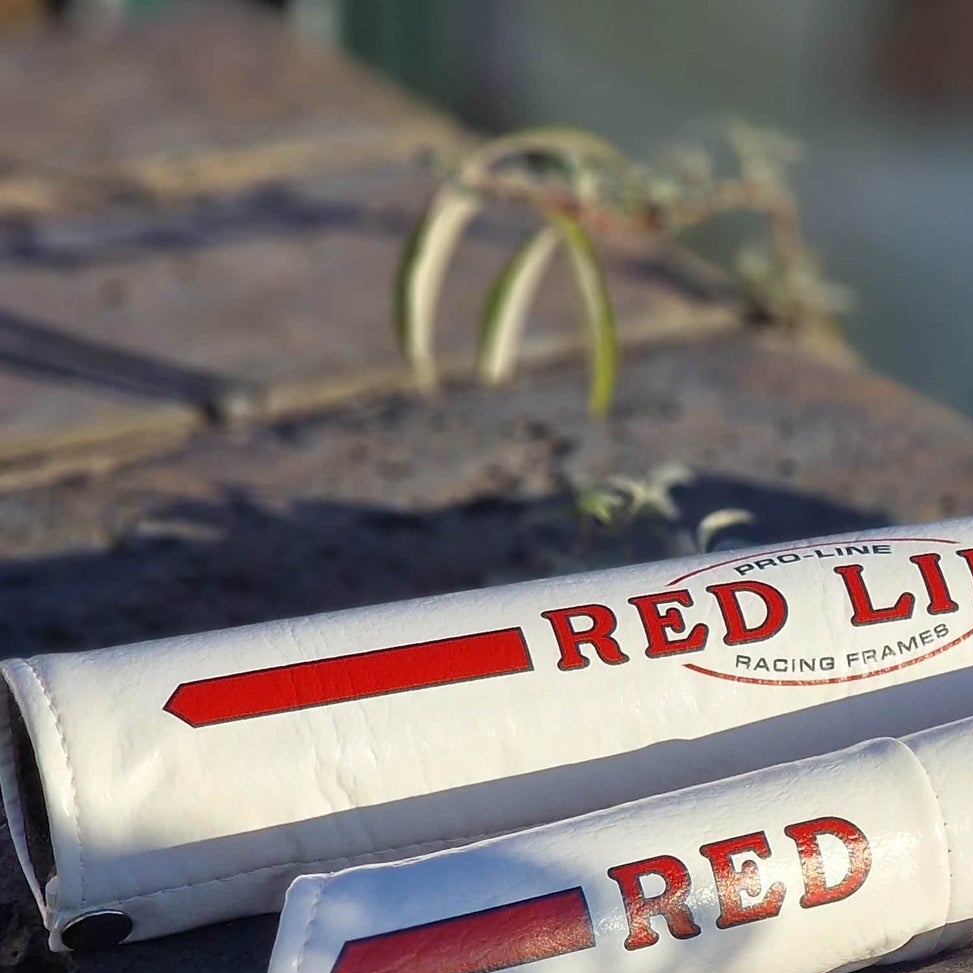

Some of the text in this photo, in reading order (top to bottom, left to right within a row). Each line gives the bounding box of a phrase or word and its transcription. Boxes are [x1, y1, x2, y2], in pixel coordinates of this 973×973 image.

[733, 543, 893, 576] PRO-LINE
[540, 579, 790, 673] RED
[735, 622, 951, 676] RACING FRAMES
[607, 815, 872, 952] RED
